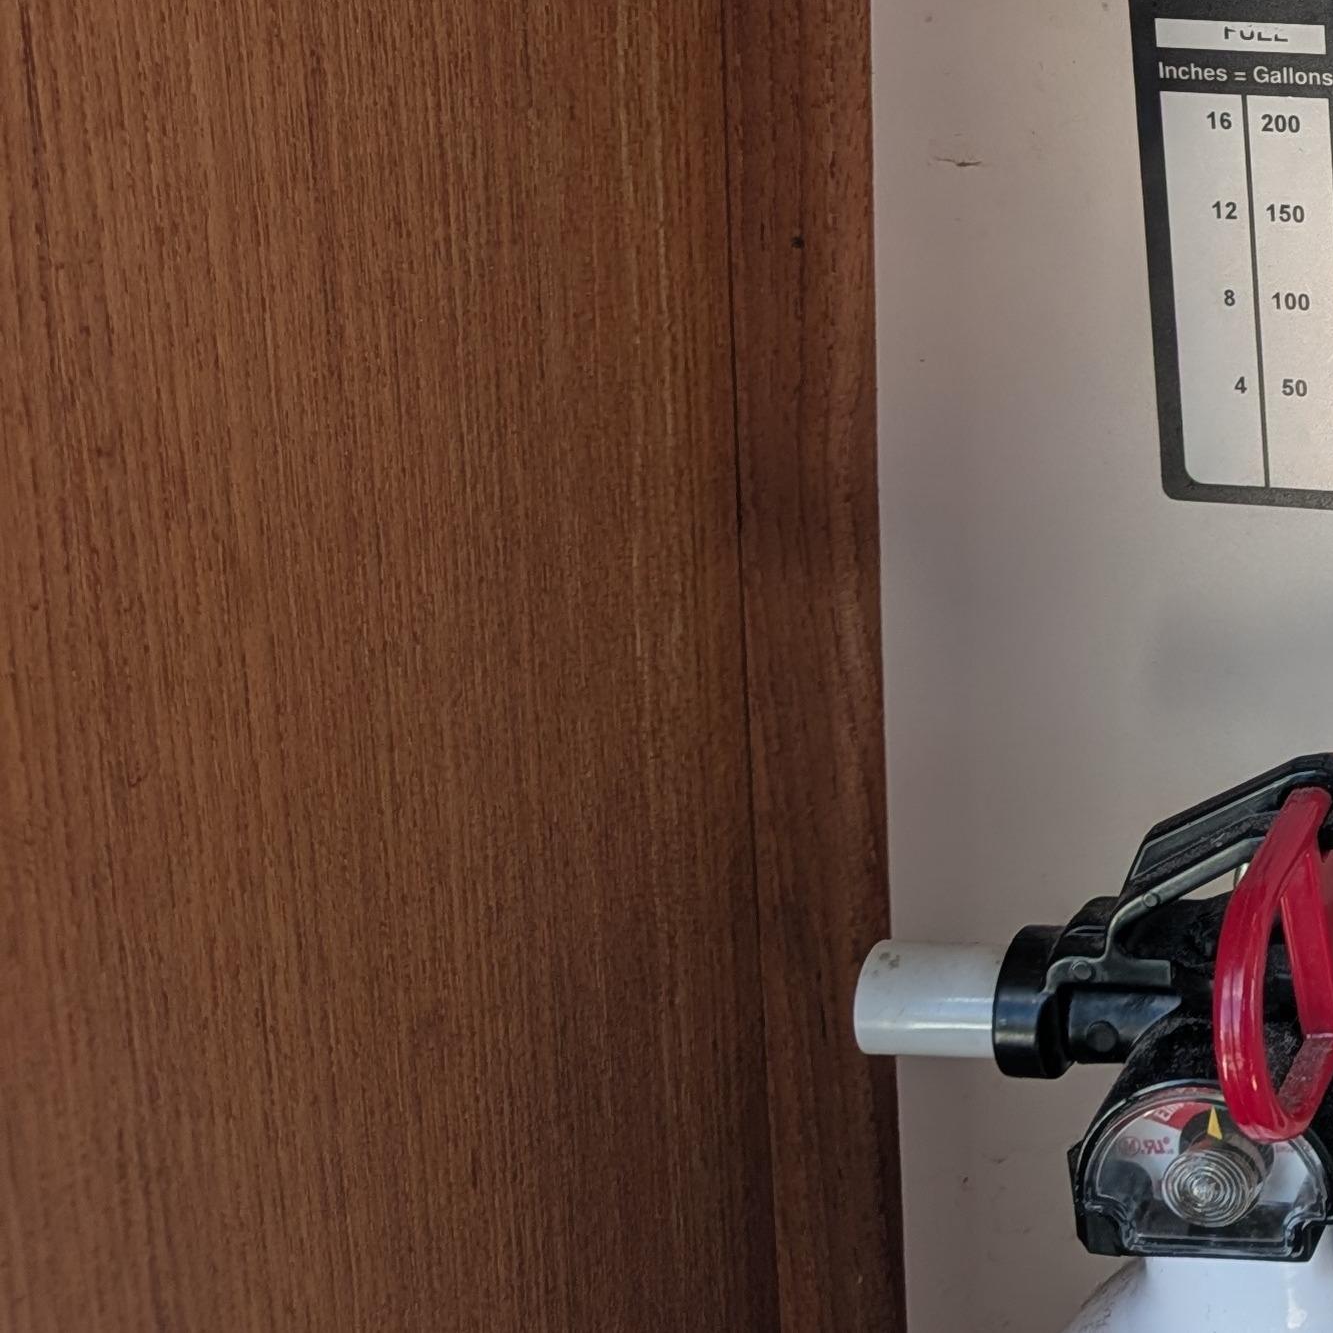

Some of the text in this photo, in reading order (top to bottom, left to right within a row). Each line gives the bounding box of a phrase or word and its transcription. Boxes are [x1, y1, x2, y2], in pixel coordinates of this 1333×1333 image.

[1158, 61, 1228, 82] Inches
[1253, 65, 1333, 87] Gallons
[1206, 111, 1232, 130] 16
[1261, 113, 1301, 134] 200
[1211, 200, 1238, 220] 12
[1266, 203, 1305, 224] 150
[1223, 289, 1236, 307] 8
[1271, 291, 1310, 311] 100
[1234, 376, 1248, 394] 4
[1281, 378, 1308, 397] 50
